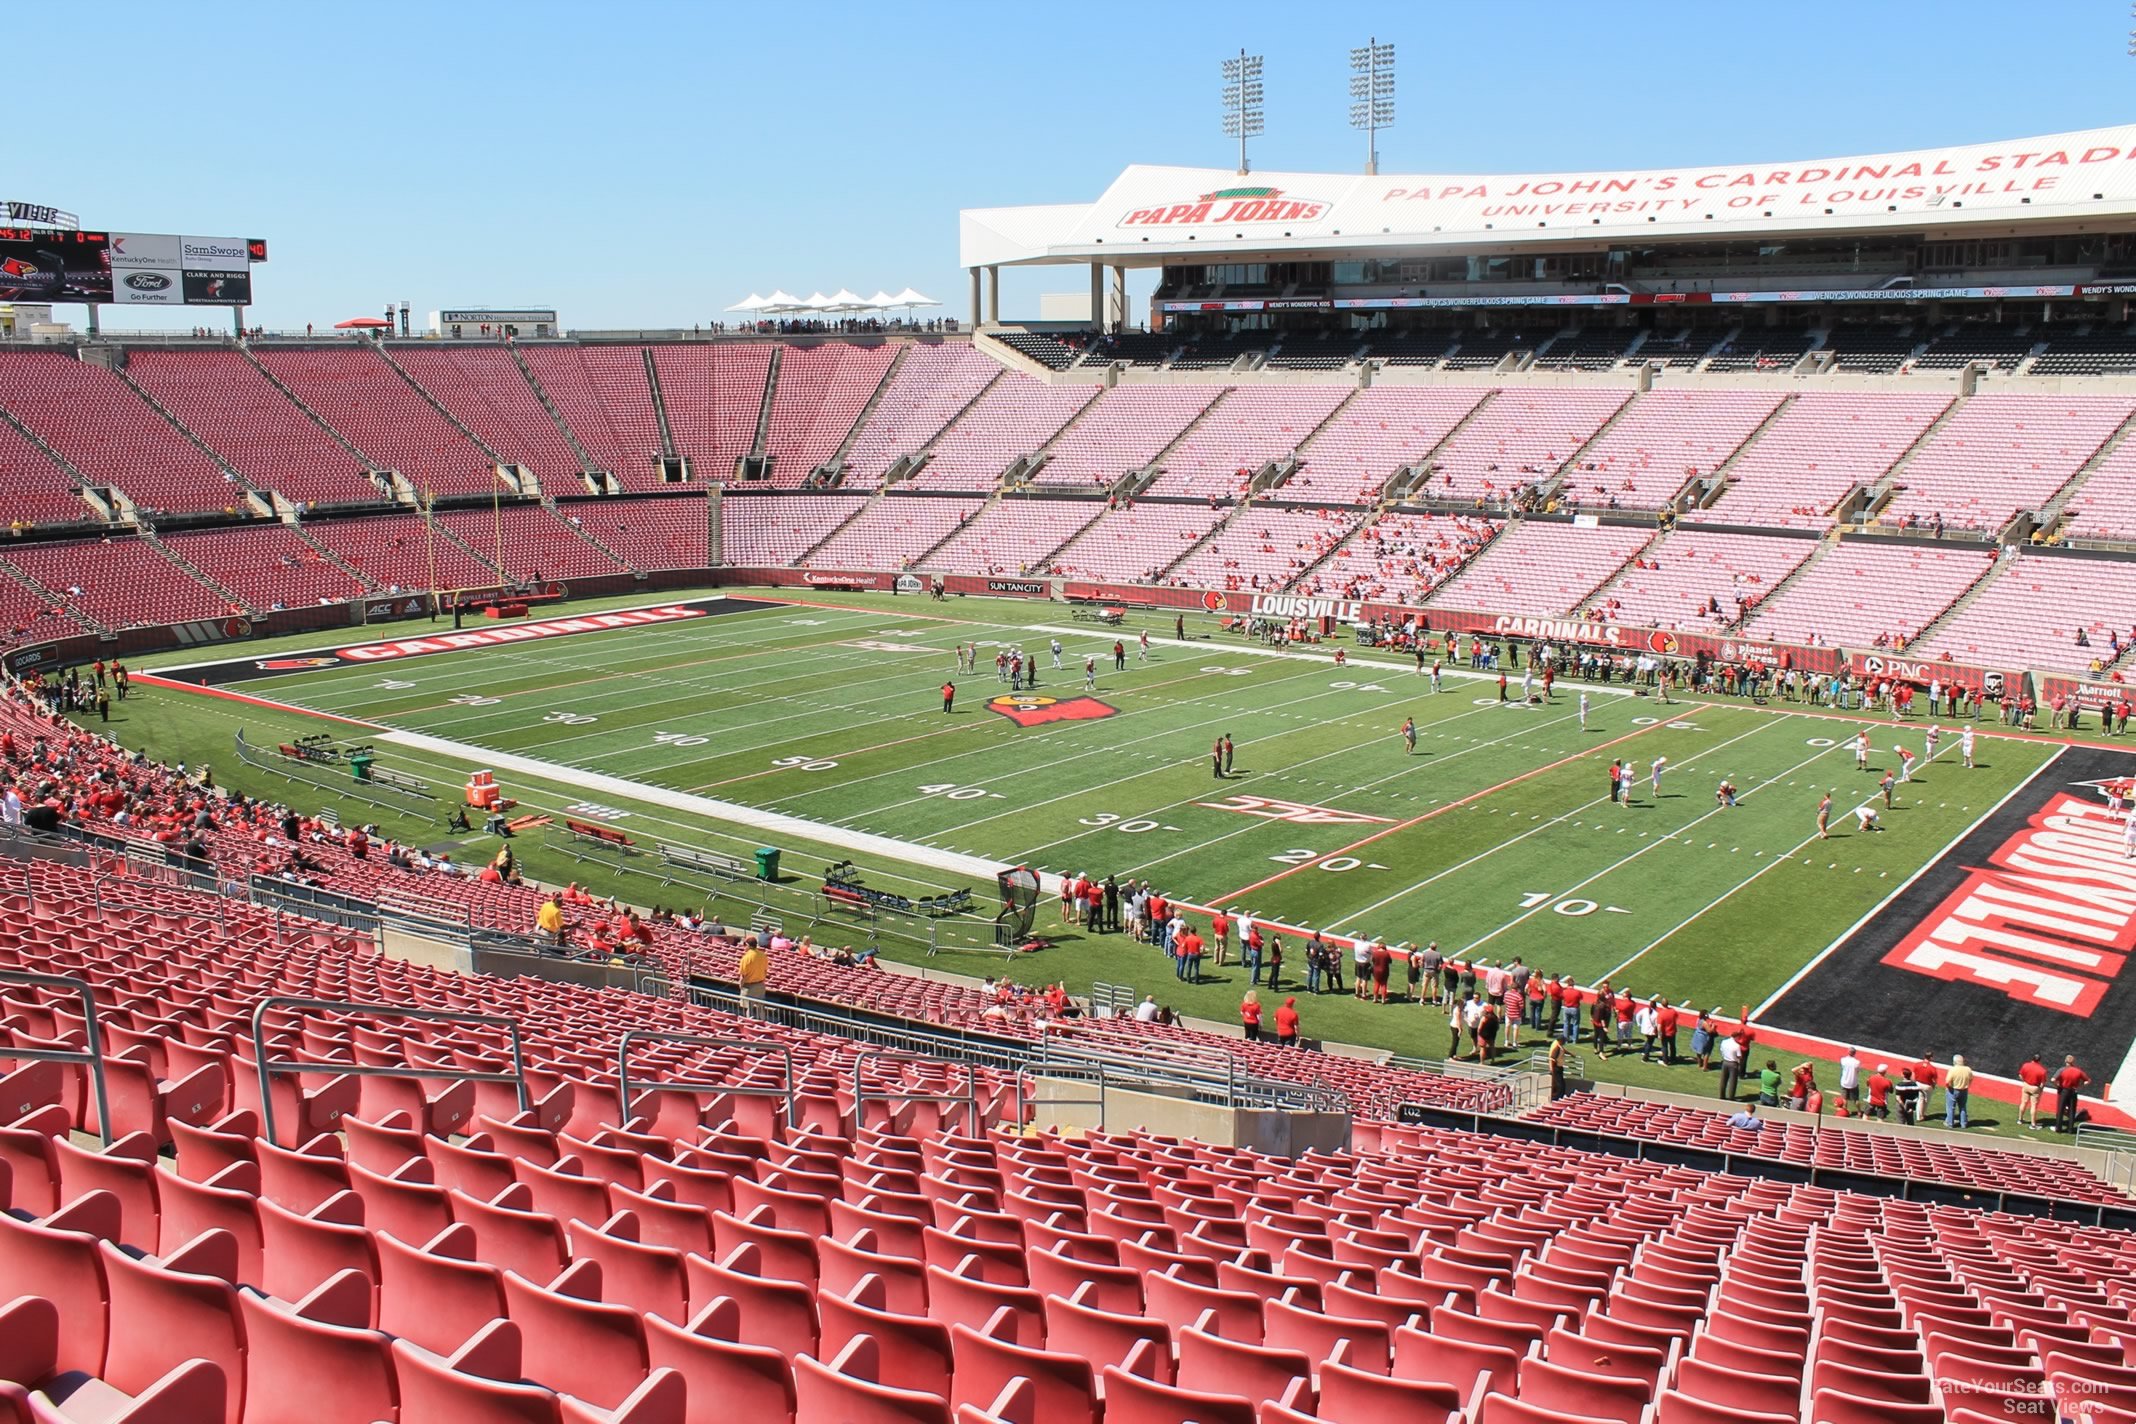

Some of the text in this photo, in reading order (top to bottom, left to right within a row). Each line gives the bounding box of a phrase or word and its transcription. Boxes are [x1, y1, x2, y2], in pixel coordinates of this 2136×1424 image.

[1382, 185, 1488, 201] PAPA
[1505, 177, 1679, 196] JOHN'S
[1695, 160, 1956, 188] CARDINAL
[1482, 176, 2060, 216] UNIVERSITY OF LOUISVILLE
[9, 203, 57, 223] VILLE
[1124, 202, 1215, 224] PAPA
[112, 256, 155, 264] KentuckyOne
[133, 275, 161, 288] Ford
[1847, 290, 1892, 299] WONDERFUL
[1894, 290, 1911, 298] KIDS
[1913, 289, 1942, 298] SPRING
[1943, 288, 1967, 297] GAME
[2082, 286, 2112, 294] WENDY'S
[1319, 300, 1330, 308] KIDS
[1500, 296, 1526, 305] SPRING
[1526, 296, 1546, 304] GAME
[855, 577, 876, 585] Health
[990, 582, 1042, 592] SUN TAN CITY
[368, 603, 392, 613] ACC
[1252, 595, 1361, 621] LOUISVILLE
[345, 605, 702, 661] CARDINALS
[1496, 616, 1620, 645] CARDINALS
[1738, 644, 1773, 656] planet
[1887, 660, 1930, 680] PNC
[2075, 684, 2121, 698] Marriott
[772, 756, 838, 772] 50
[917, 784, 987, 800] 40
[1079, 814, 1159, 833] 30
[1269, 849, 1362, 872] 20
[1518, 892, 1599, 916] 10
[1403, 1107, 1421, 1117] 102
